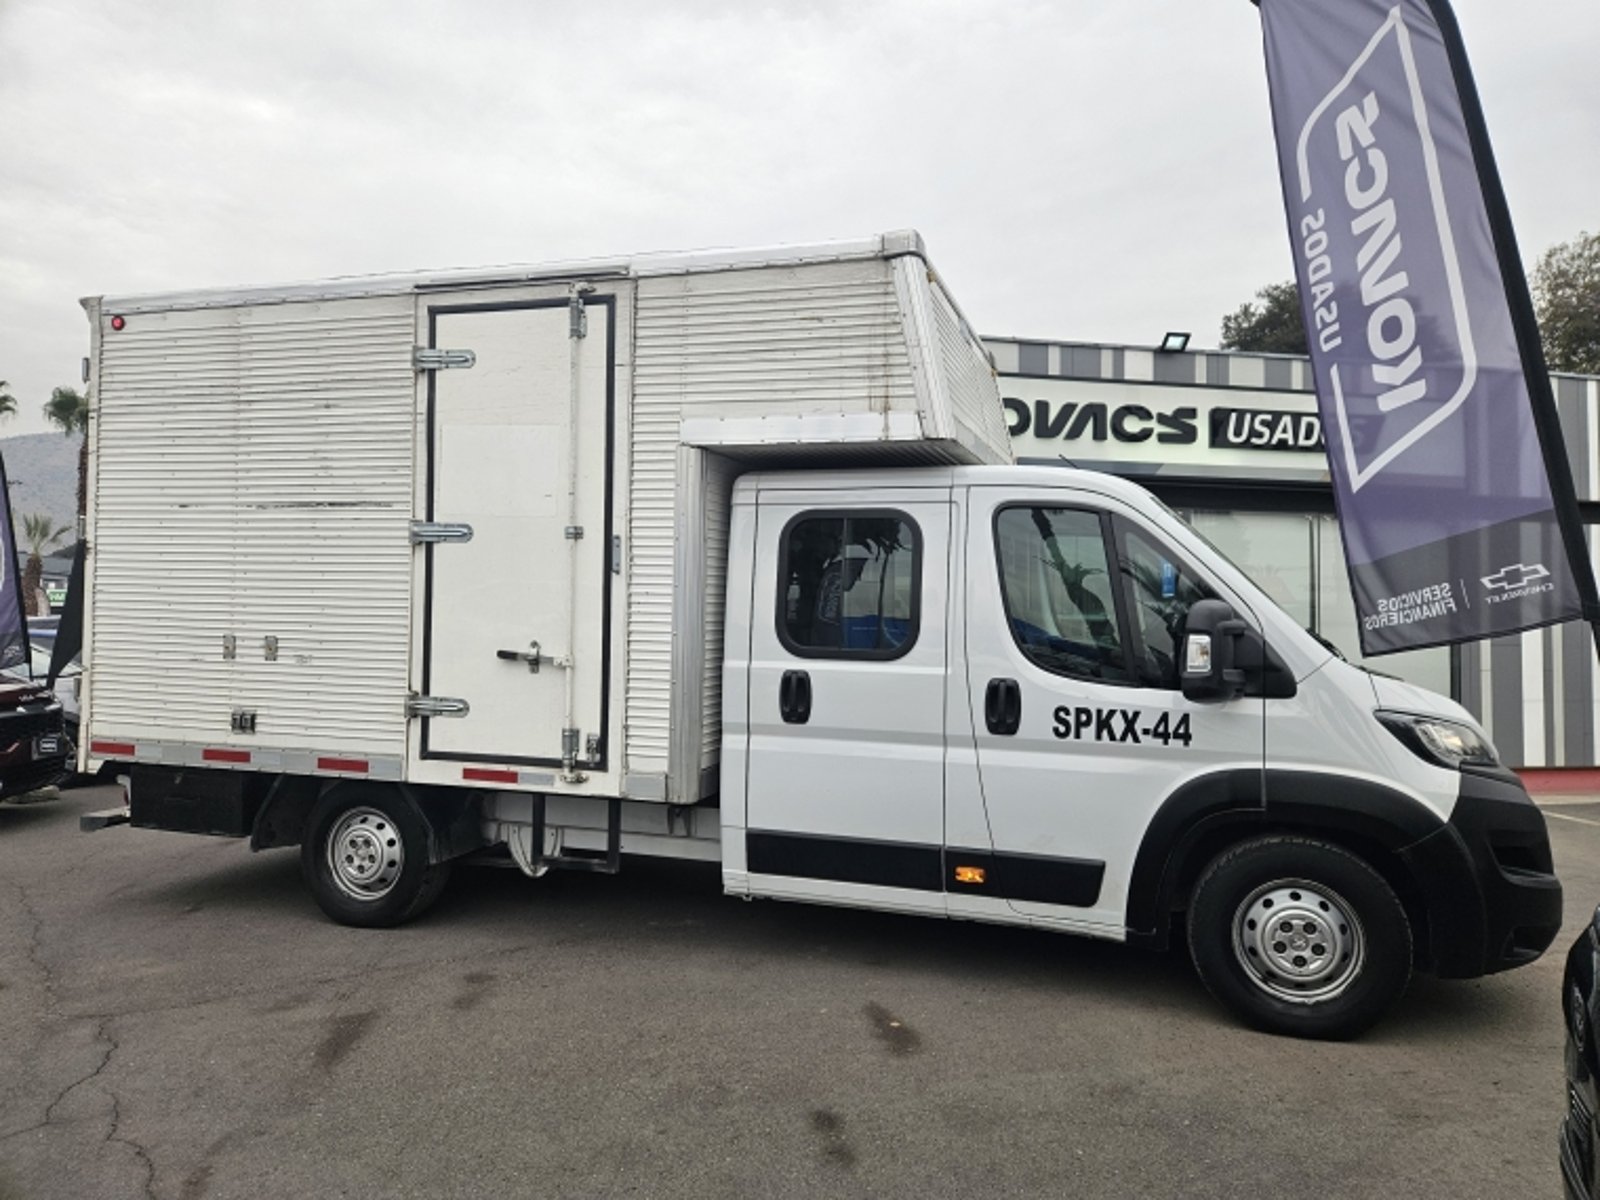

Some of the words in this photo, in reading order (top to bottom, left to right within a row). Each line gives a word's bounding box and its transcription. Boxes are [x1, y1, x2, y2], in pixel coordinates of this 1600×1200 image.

[1001, 397, 1198, 445] OVACS
[1227, 412, 1325, 447] USAD
[1052, 704, 1192, 747] SPKX-44
